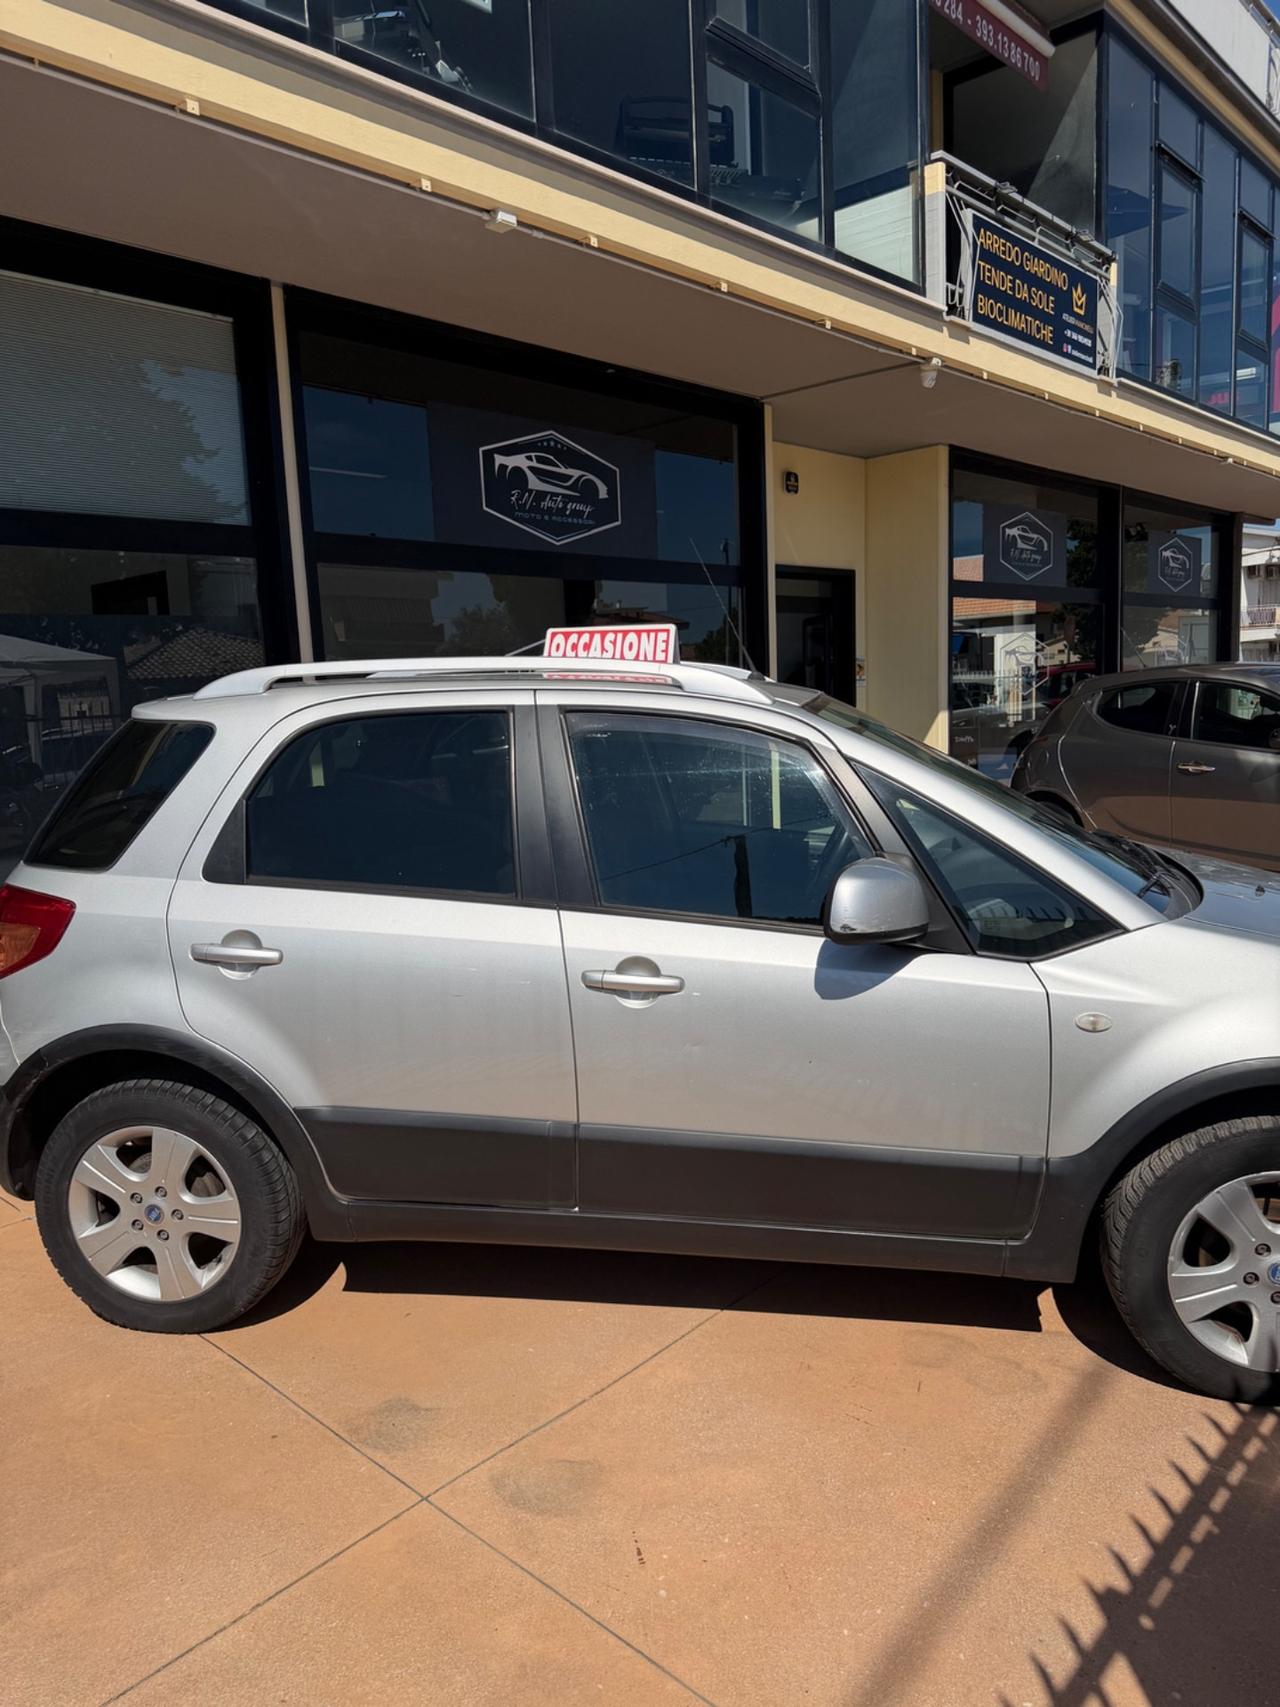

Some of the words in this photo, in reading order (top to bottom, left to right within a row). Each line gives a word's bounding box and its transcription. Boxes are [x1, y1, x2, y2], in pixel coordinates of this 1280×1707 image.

[979, 228, 1022, 266] ARREDO
[1022, 251, 1069, 292] GIARDINO
[978, 260, 1013, 296] TENDE
[1015, 279, 1029, 304] DA
[1030, 287, 1055, 315] SOLE
[977, 293, 1054, 345] BIOCLIMATICHE
[550, 631, 668, 662] OCCASIONE
